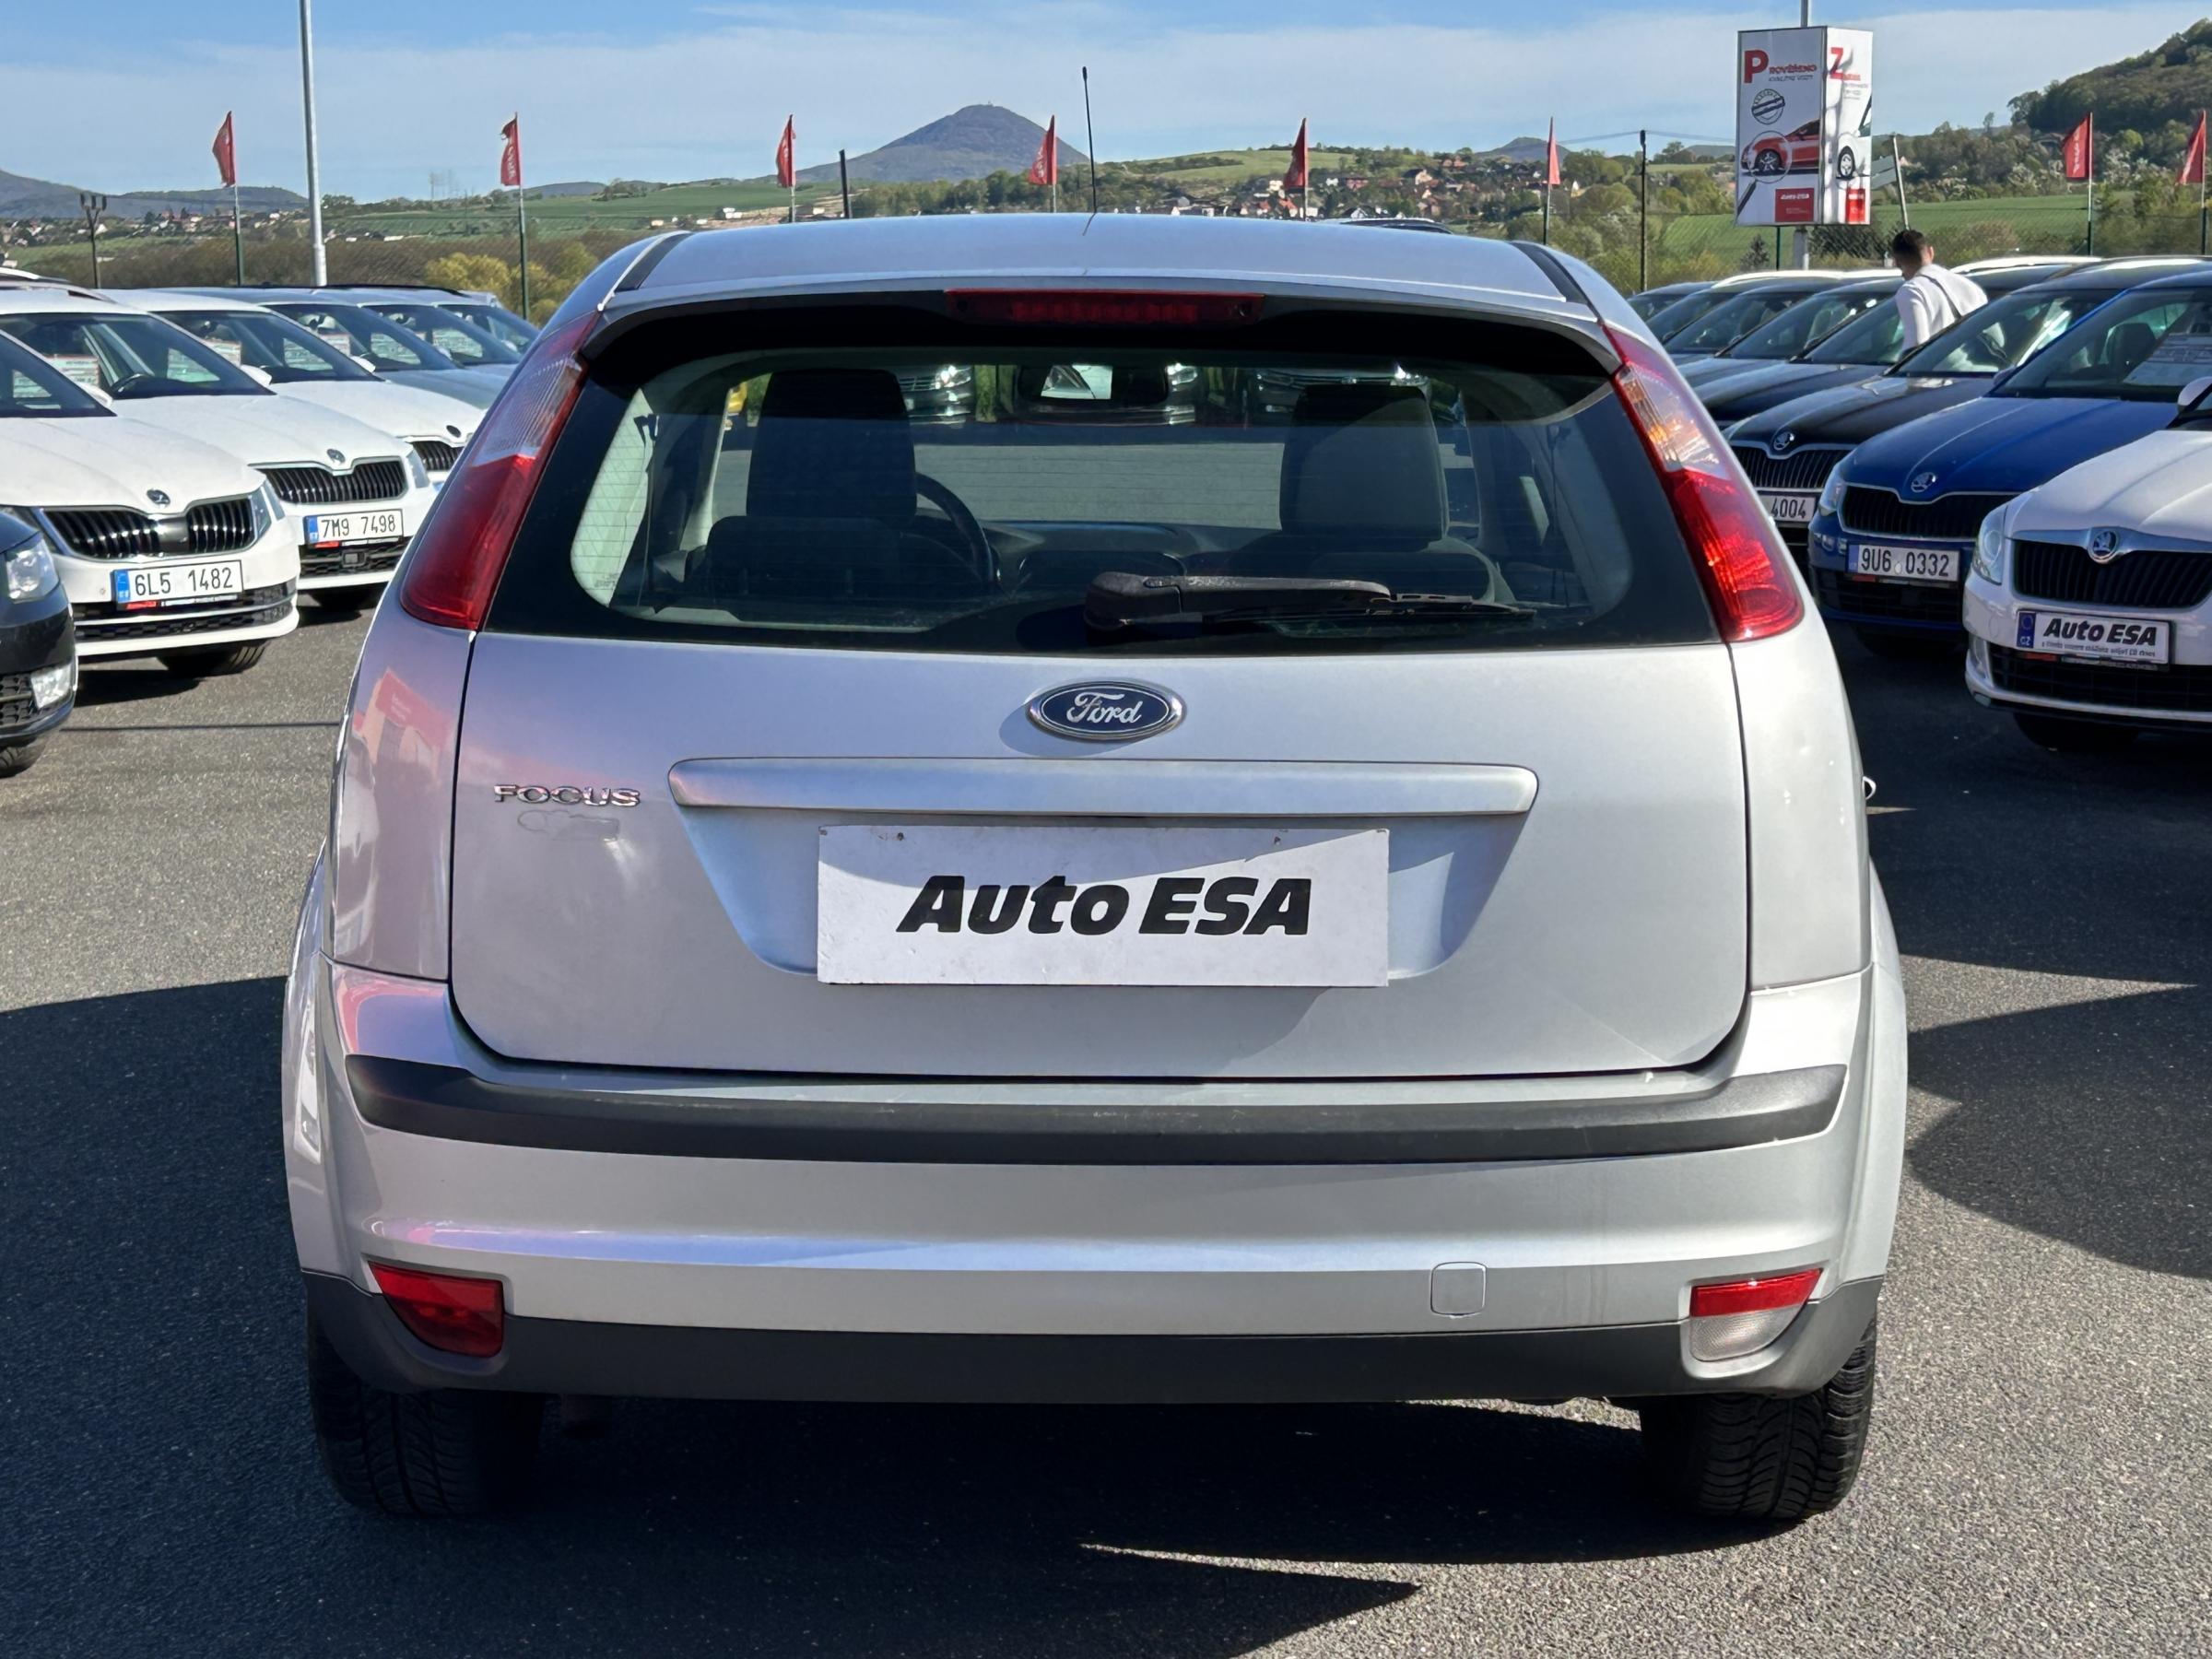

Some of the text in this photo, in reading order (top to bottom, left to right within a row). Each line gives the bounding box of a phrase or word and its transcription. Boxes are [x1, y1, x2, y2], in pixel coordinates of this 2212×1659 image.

[1771, 498, 1806, 518] 4004
[321, 514, 396, 538] 7M9 7498
[1861, 547, 1950, 577] 9U6 0332
[135, 567, 233, 596] 6L5 1482
[2043, 618, 2158, 646] Auto ESA
[1065, 691, 1144, 724] Ford
[493, 784, 641, 807] FOCUS
[895, 874, 1312, 935] Auto ESA
